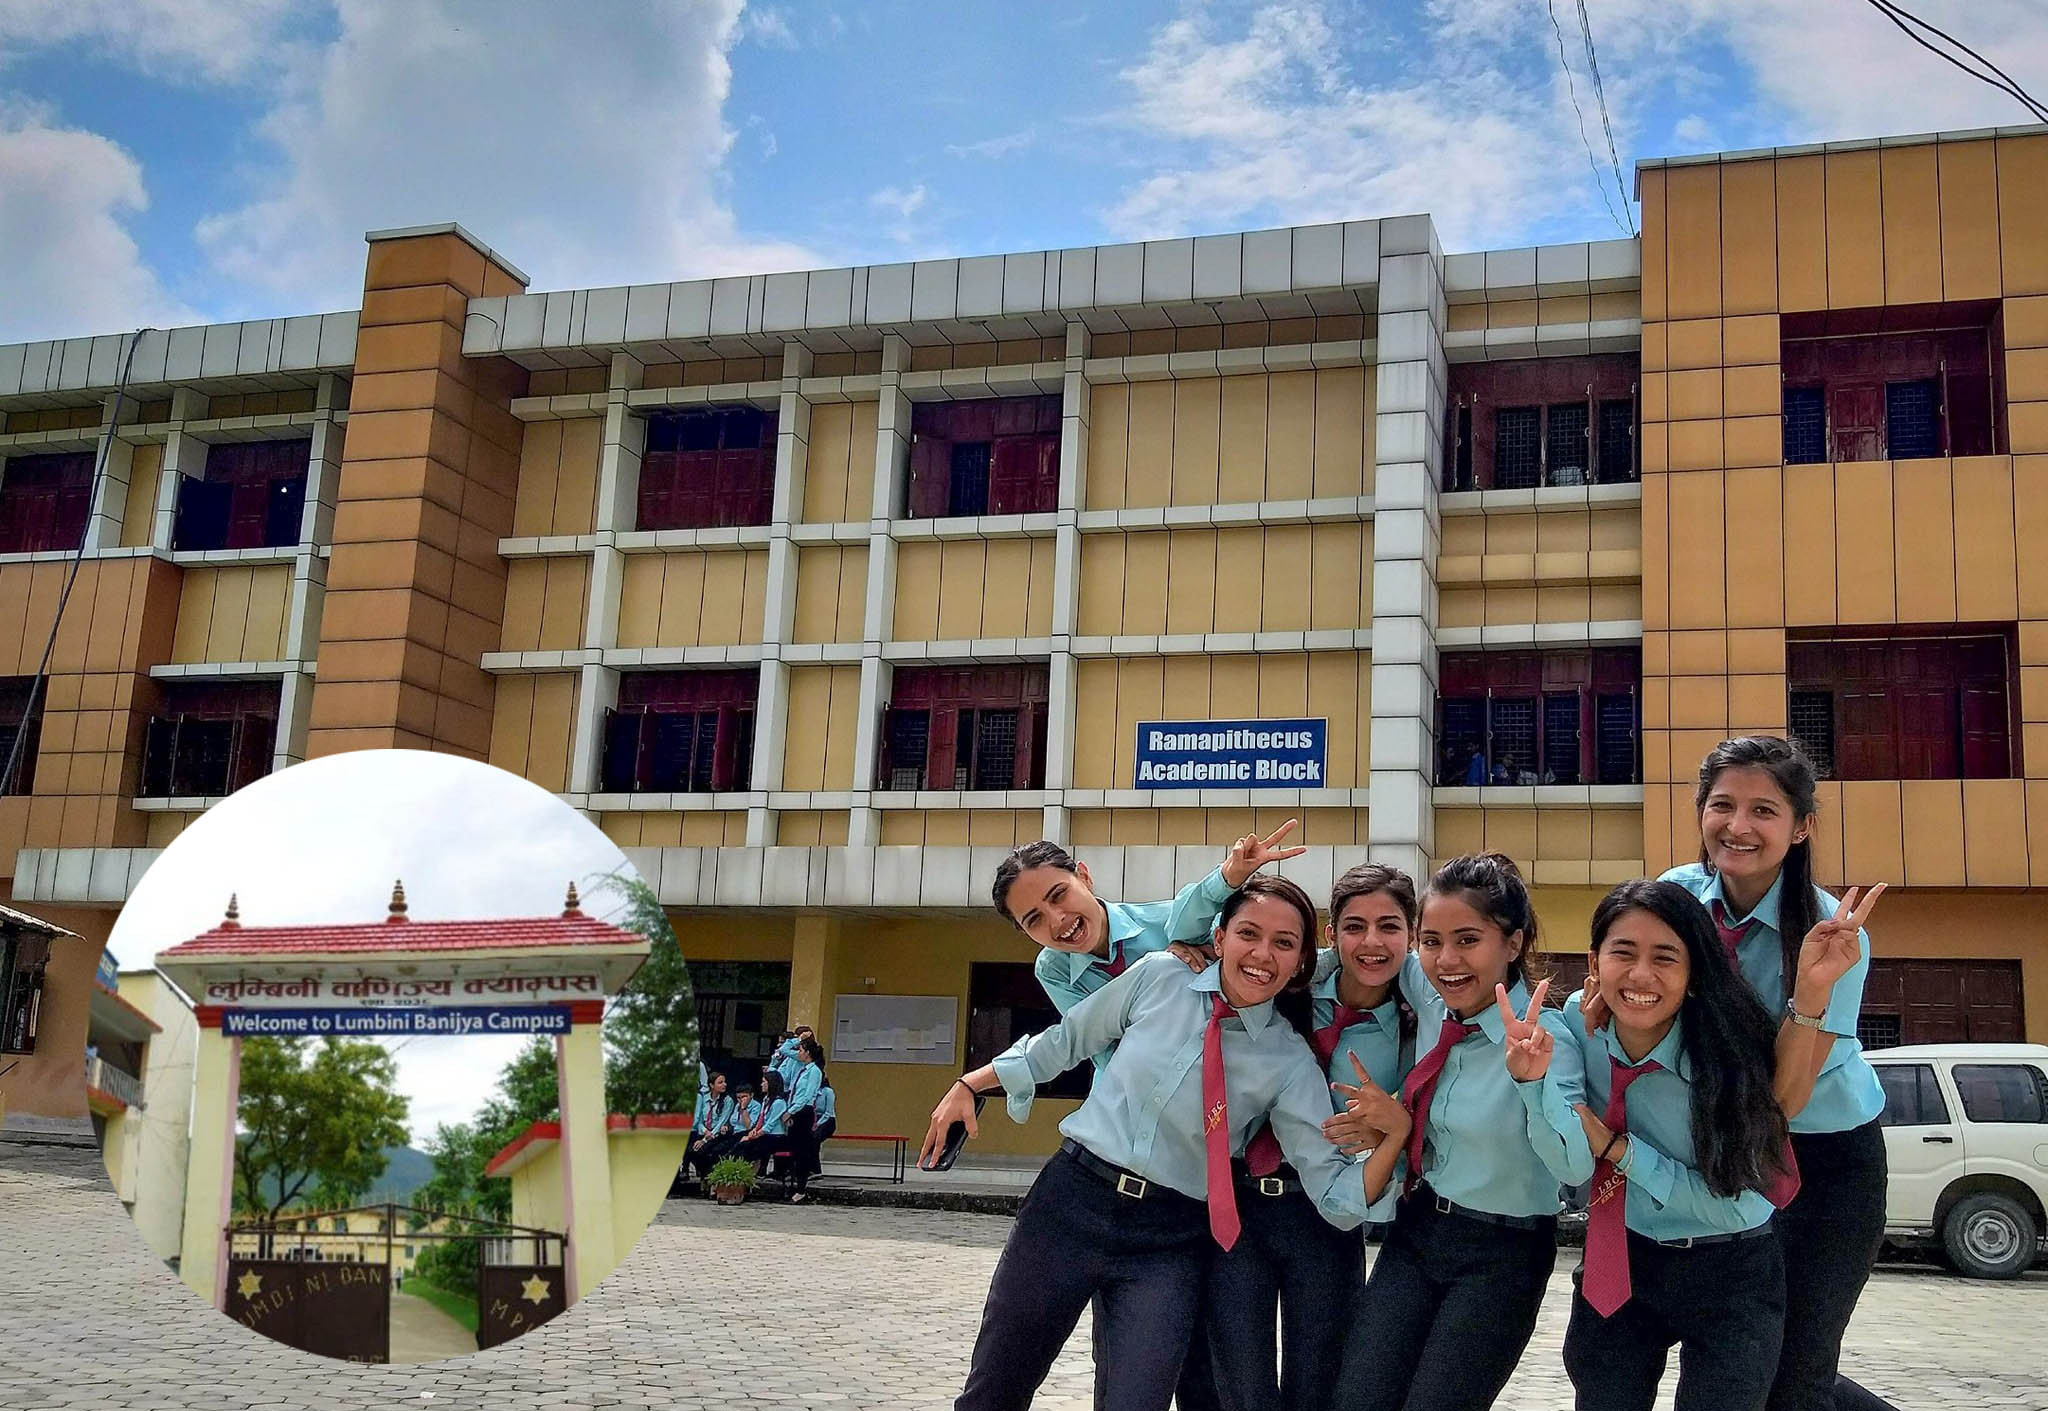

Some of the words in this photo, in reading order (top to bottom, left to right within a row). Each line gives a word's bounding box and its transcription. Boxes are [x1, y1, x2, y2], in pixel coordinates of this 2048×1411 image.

[1149, 729, 1313, 752] Ramapithecus
[1138, 760, 1250, 781] Academic
[1255, 759, 1321, 780] Block
[228, 1014, 308, 1031] Welcome
[312, 1015, 332, 1031] to
[335, 1012, 410, 1031] Lumbini
[414, 1012, 483, 1034] Banijya
[488, 1011, 564, 1031] Campus
[1598, 1175, 1620, 1196] LBC
